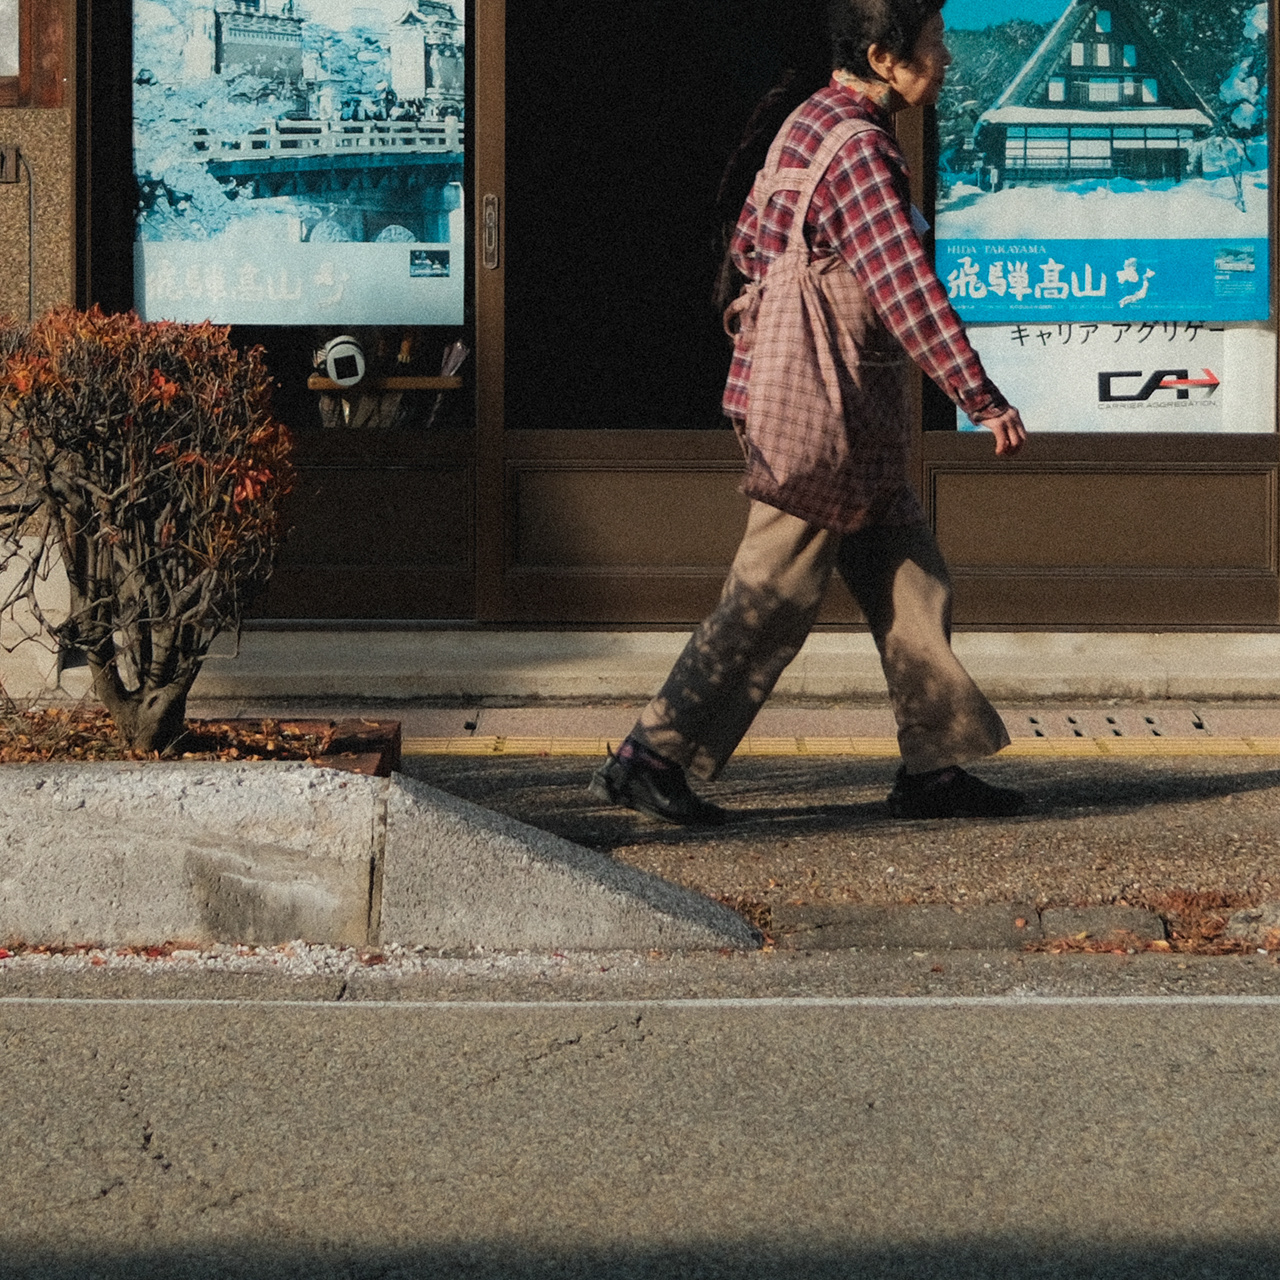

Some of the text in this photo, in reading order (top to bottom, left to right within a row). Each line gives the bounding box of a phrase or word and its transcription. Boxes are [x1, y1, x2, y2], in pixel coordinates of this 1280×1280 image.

[984, 245, 1046, 254] TAKAYAMA
[146, 259, 302, 303] 飛騨高山
[947, 256, 1107, 302] 飛騨高山
[1010, 323, 1098, 347] キャリア
